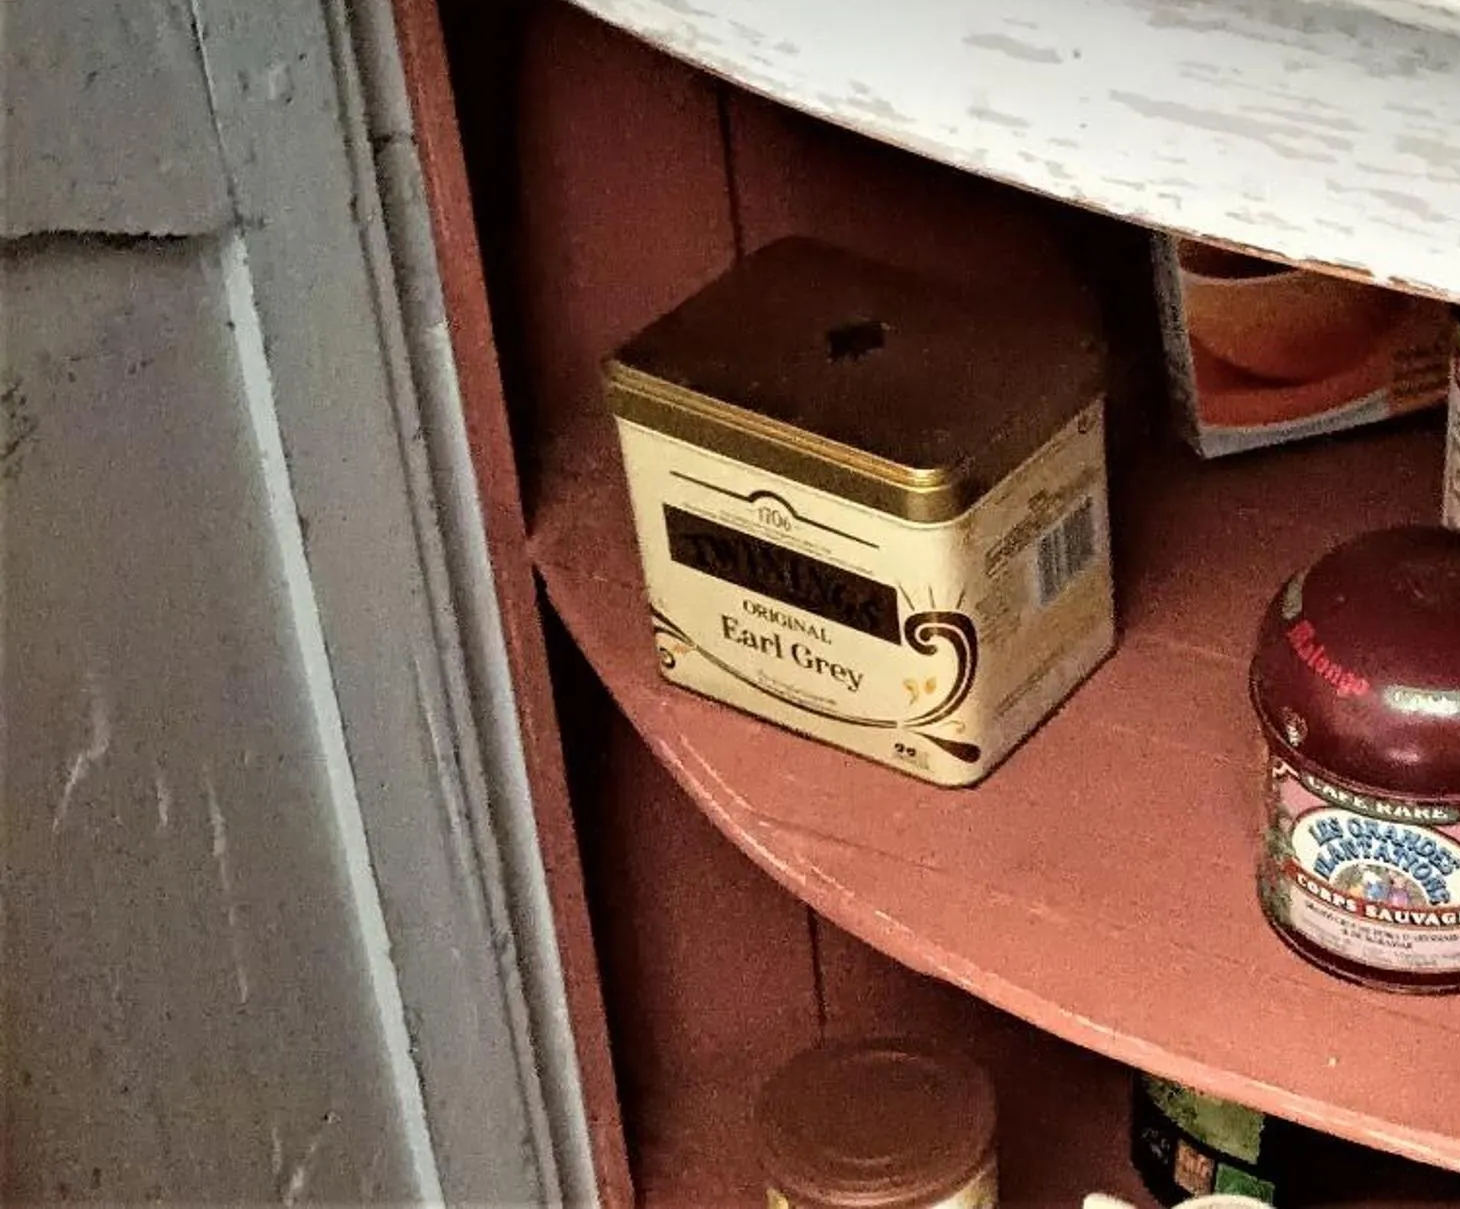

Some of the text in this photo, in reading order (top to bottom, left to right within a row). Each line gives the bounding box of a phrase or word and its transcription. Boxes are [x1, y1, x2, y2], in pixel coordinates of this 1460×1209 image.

[721, 614, 784, 660] Earl
[790, 641, 864, 693] Grey
[742, 599, 833, 646] ORIGINAL
